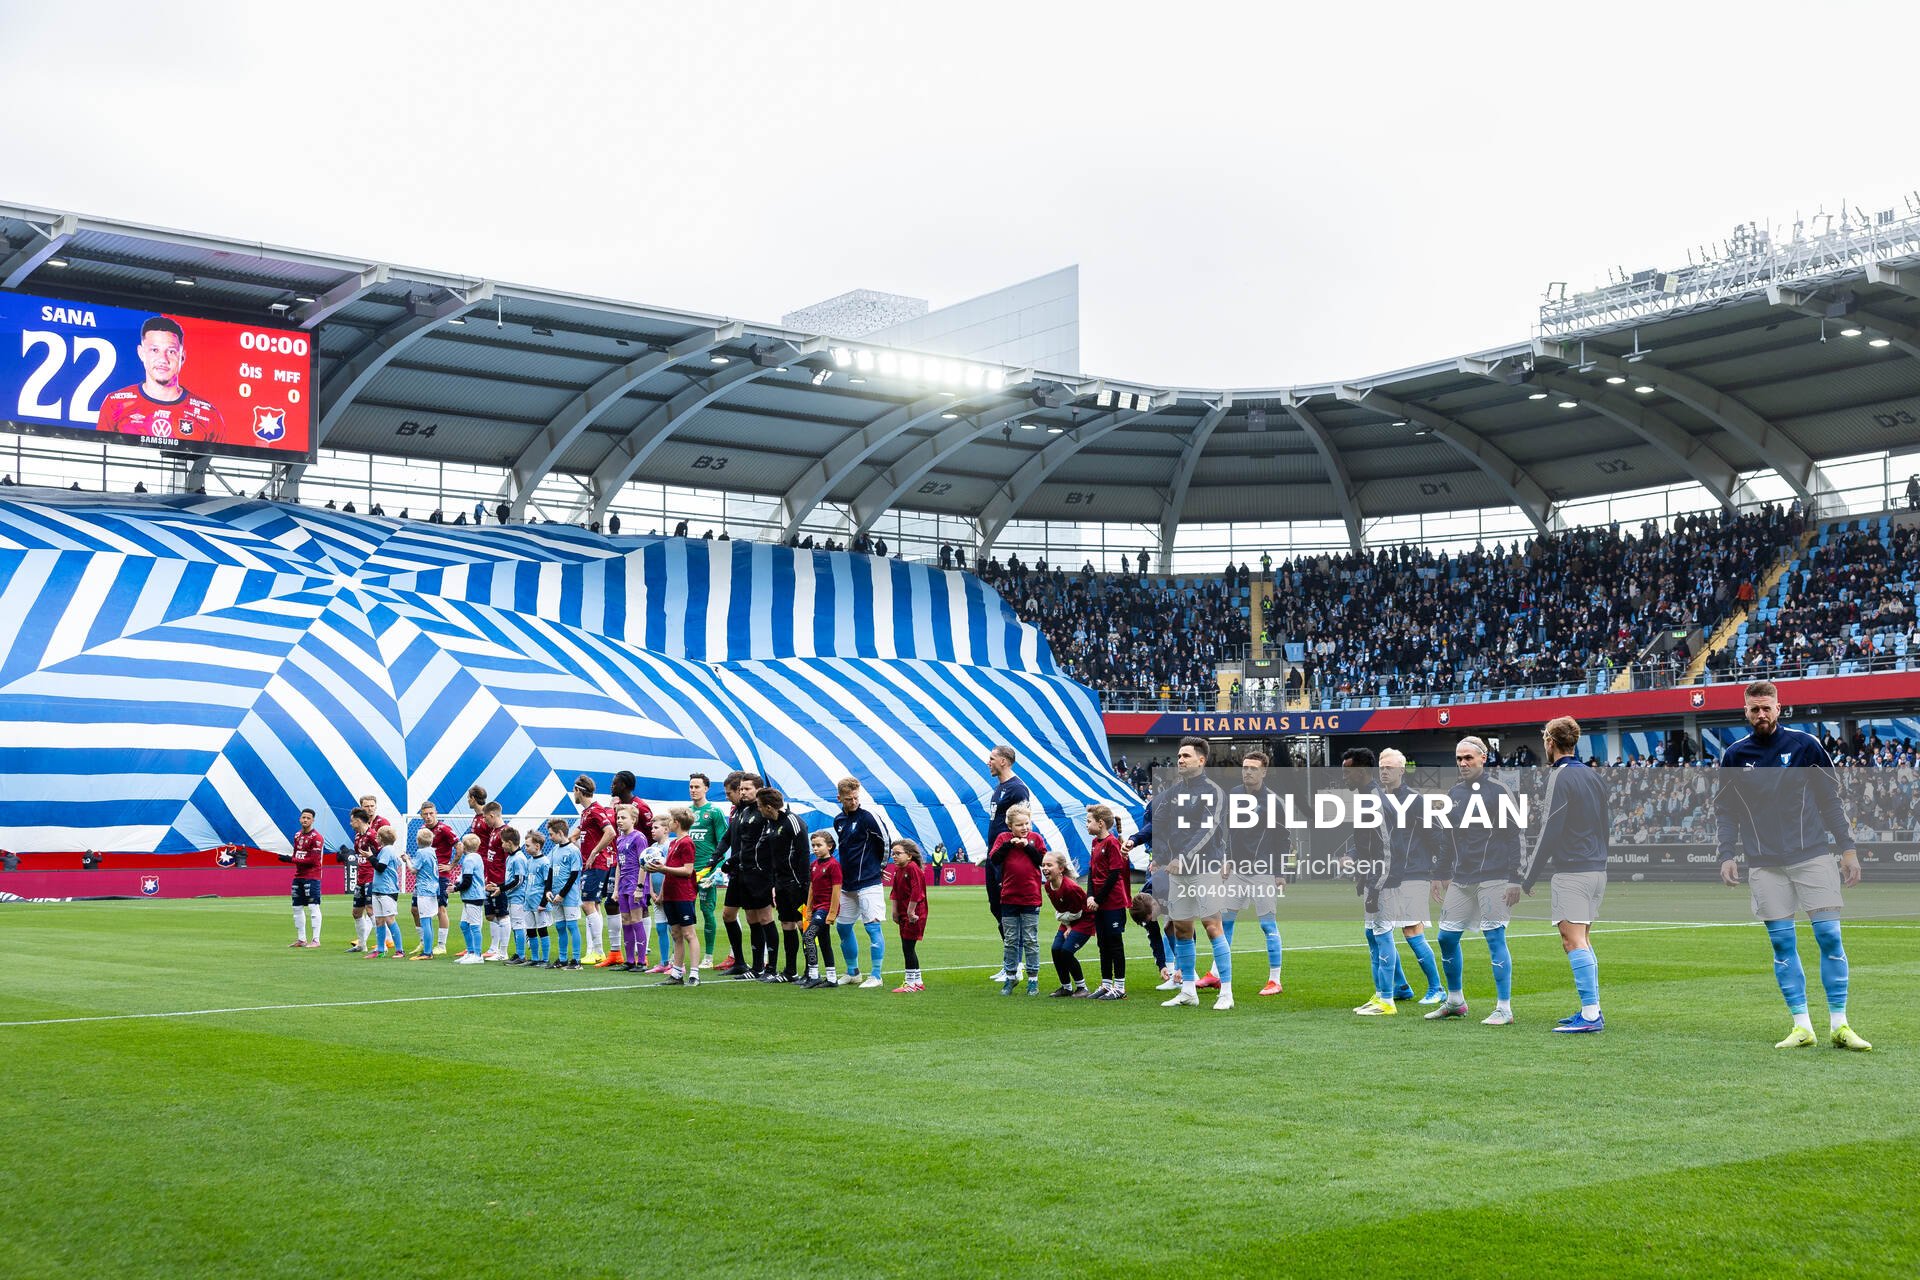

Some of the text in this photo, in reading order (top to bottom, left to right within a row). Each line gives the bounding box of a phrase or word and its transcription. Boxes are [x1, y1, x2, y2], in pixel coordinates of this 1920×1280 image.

[41, 305, 97, 328] SANA
[239, 331, 308, 357] 00:00
[17, 329, 117, 424] 22
[239, 363, 301, 384] ÖIS MFF
[239, 383, 300, 403] 0 0
[396, 421, 438, 439] B4
[140, 435, 179, 446] SAMSUNG
[691, 455, 729, 471] B3
[1595, 459, 1635, 475] D2
[917, 480, 952, 496] B2
[1420, 482, 1452, 496] D1
[1065, 492, 1097, 505] B1
[1182, 715, 1340, 732] LIRARNAS LAG
[1607, 853, 1649, 863] mla Ullevi
[1687, 853, 1716, 863] Gamla
